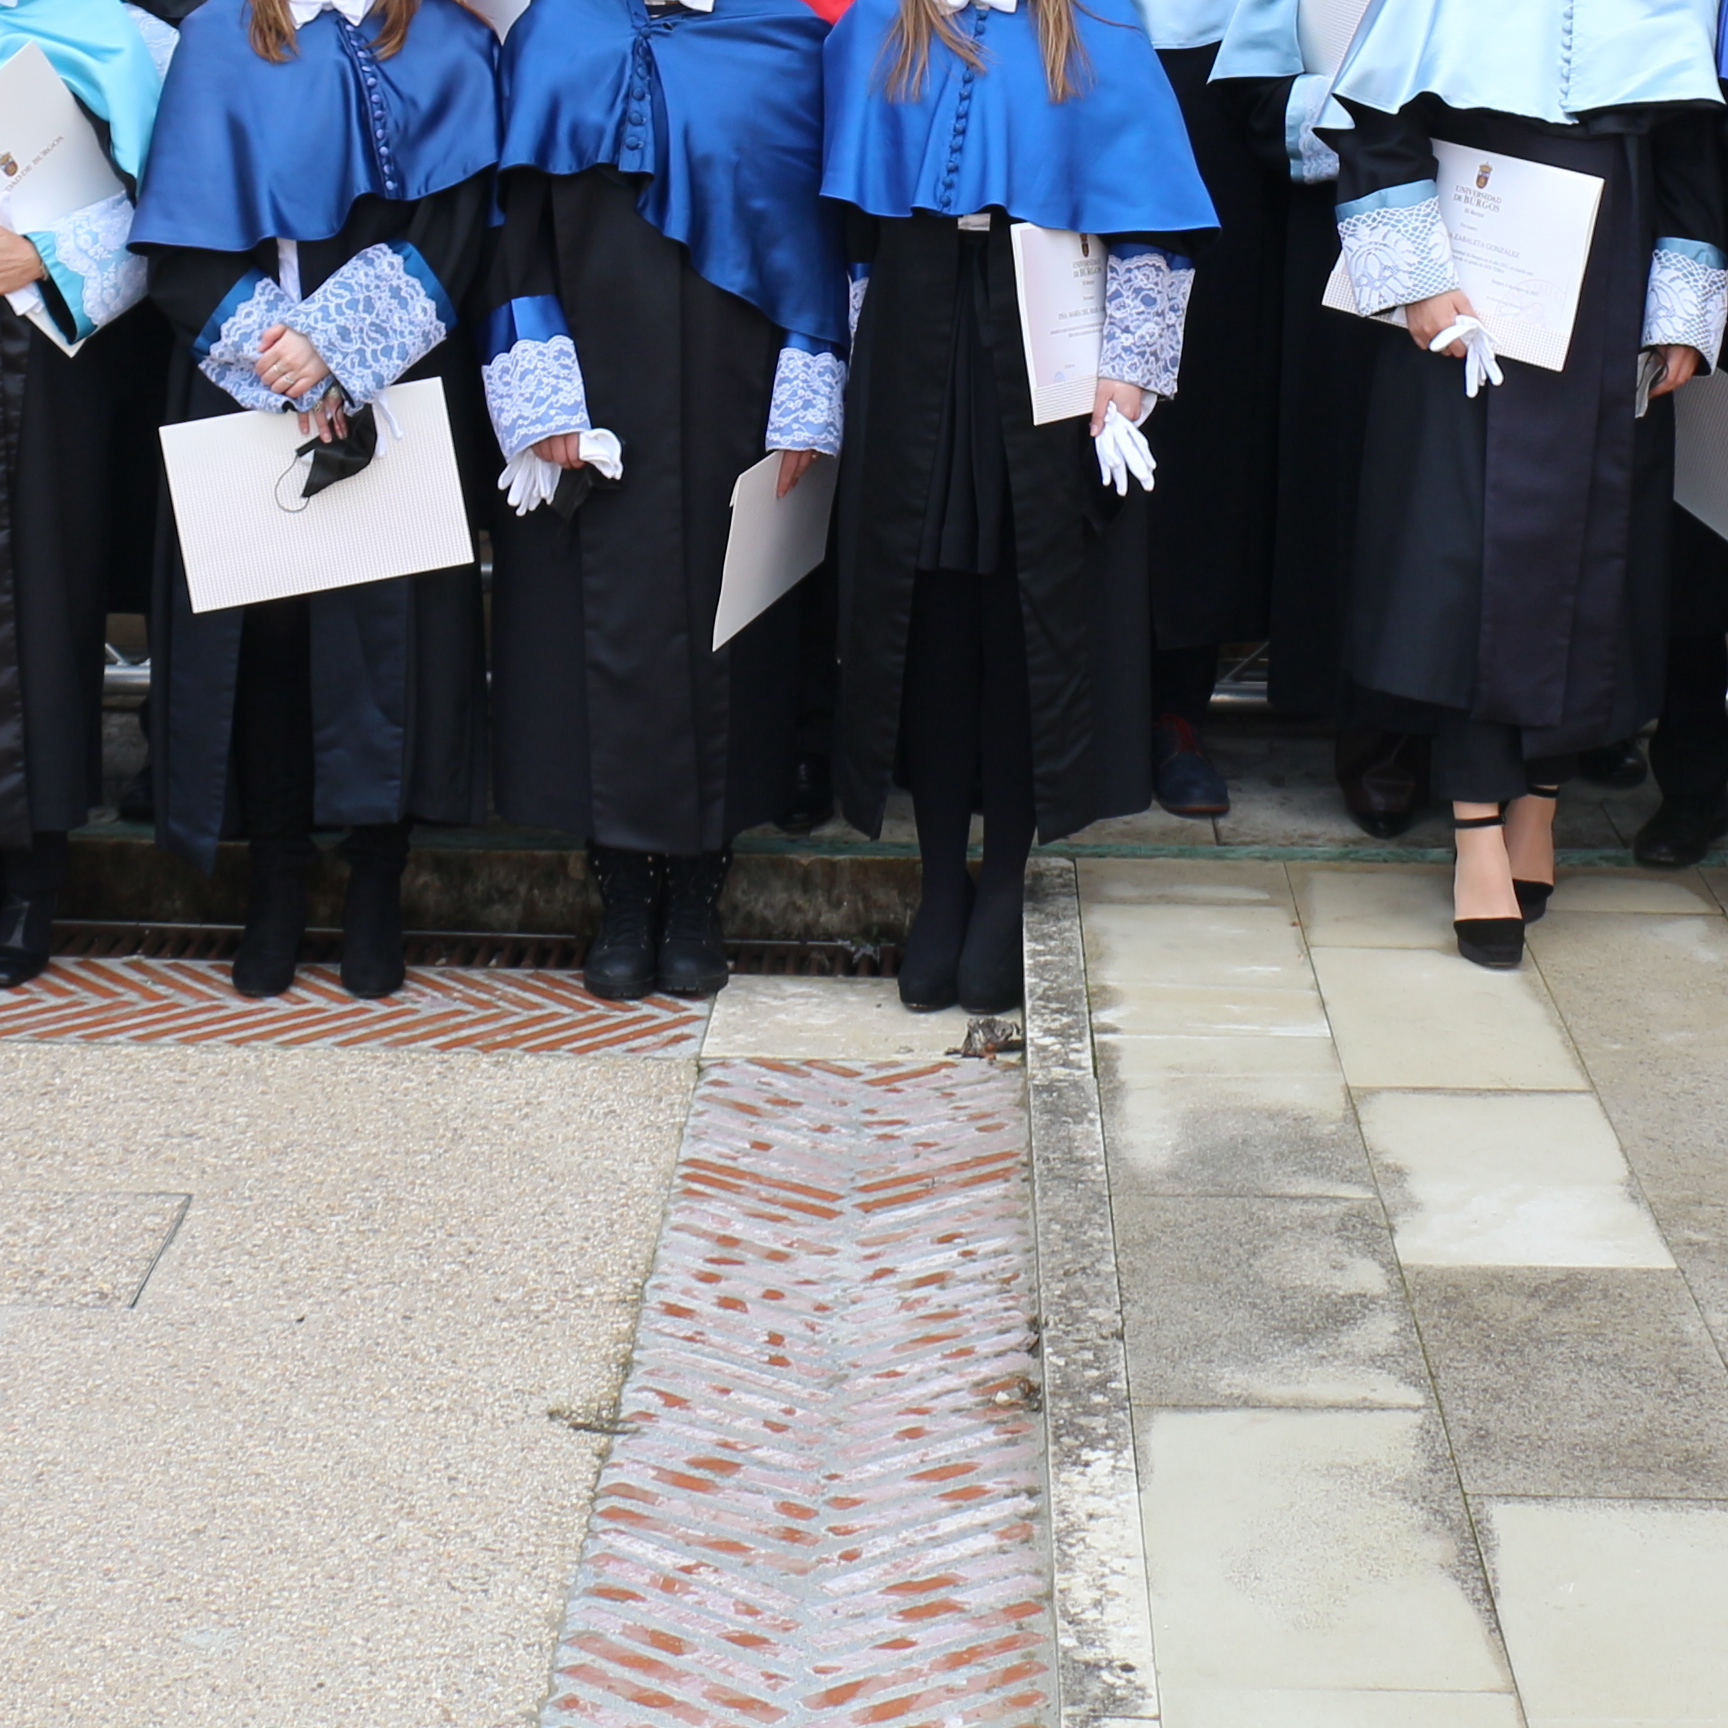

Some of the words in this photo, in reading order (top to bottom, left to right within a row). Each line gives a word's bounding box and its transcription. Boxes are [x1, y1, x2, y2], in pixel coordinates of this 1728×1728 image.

[20, 164, 33, 177] DE
[32, 135, 64, 166] BURGOS
[1453, 192, 1463, 202] DE
[1462, 194, 1500, 213] BURGOS
[1455, 184, 1502, 204] UNIVERSIDAD
